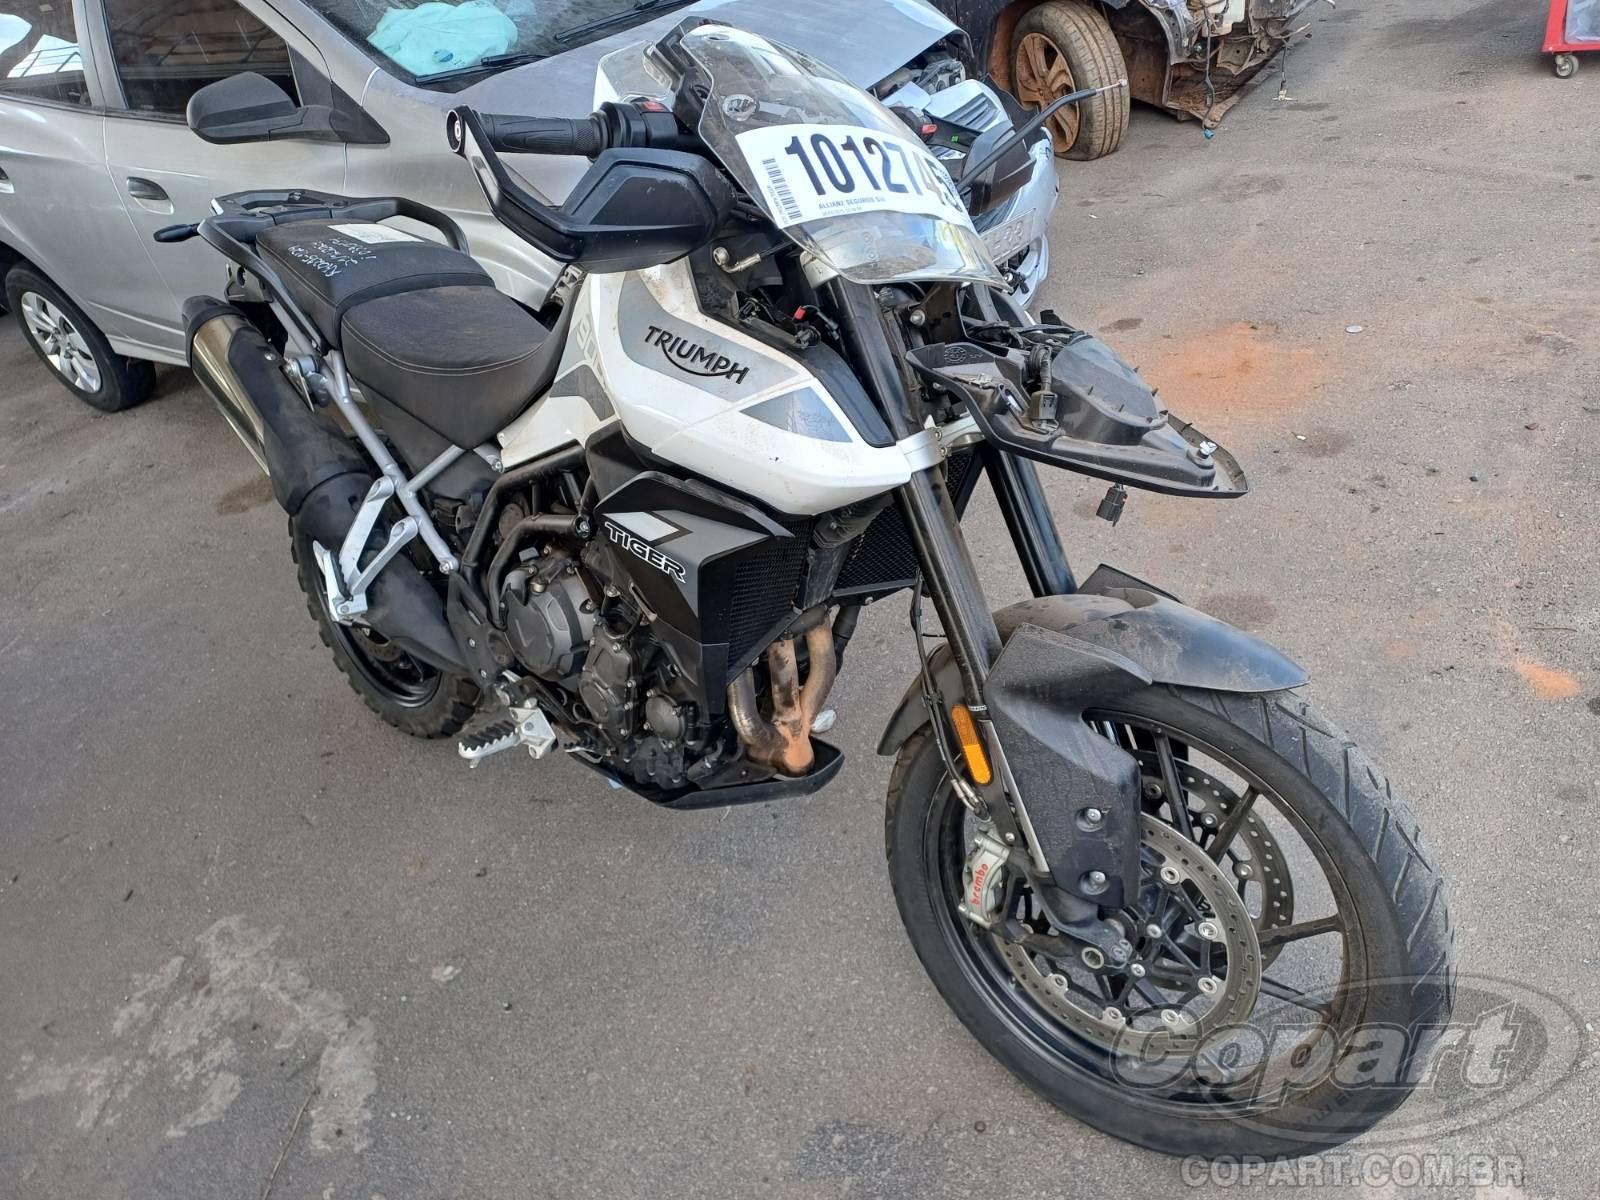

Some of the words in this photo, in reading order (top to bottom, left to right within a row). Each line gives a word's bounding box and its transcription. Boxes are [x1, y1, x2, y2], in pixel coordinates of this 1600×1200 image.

[818, 200, 844, 209] ALLIANZ
[846, 197, 875, 206] SEGUROS
[644, 325, 751, 384] TRIUMPH
[604, 521, 686, 584] TIGER
[969, 863, 989, 906] brembo
